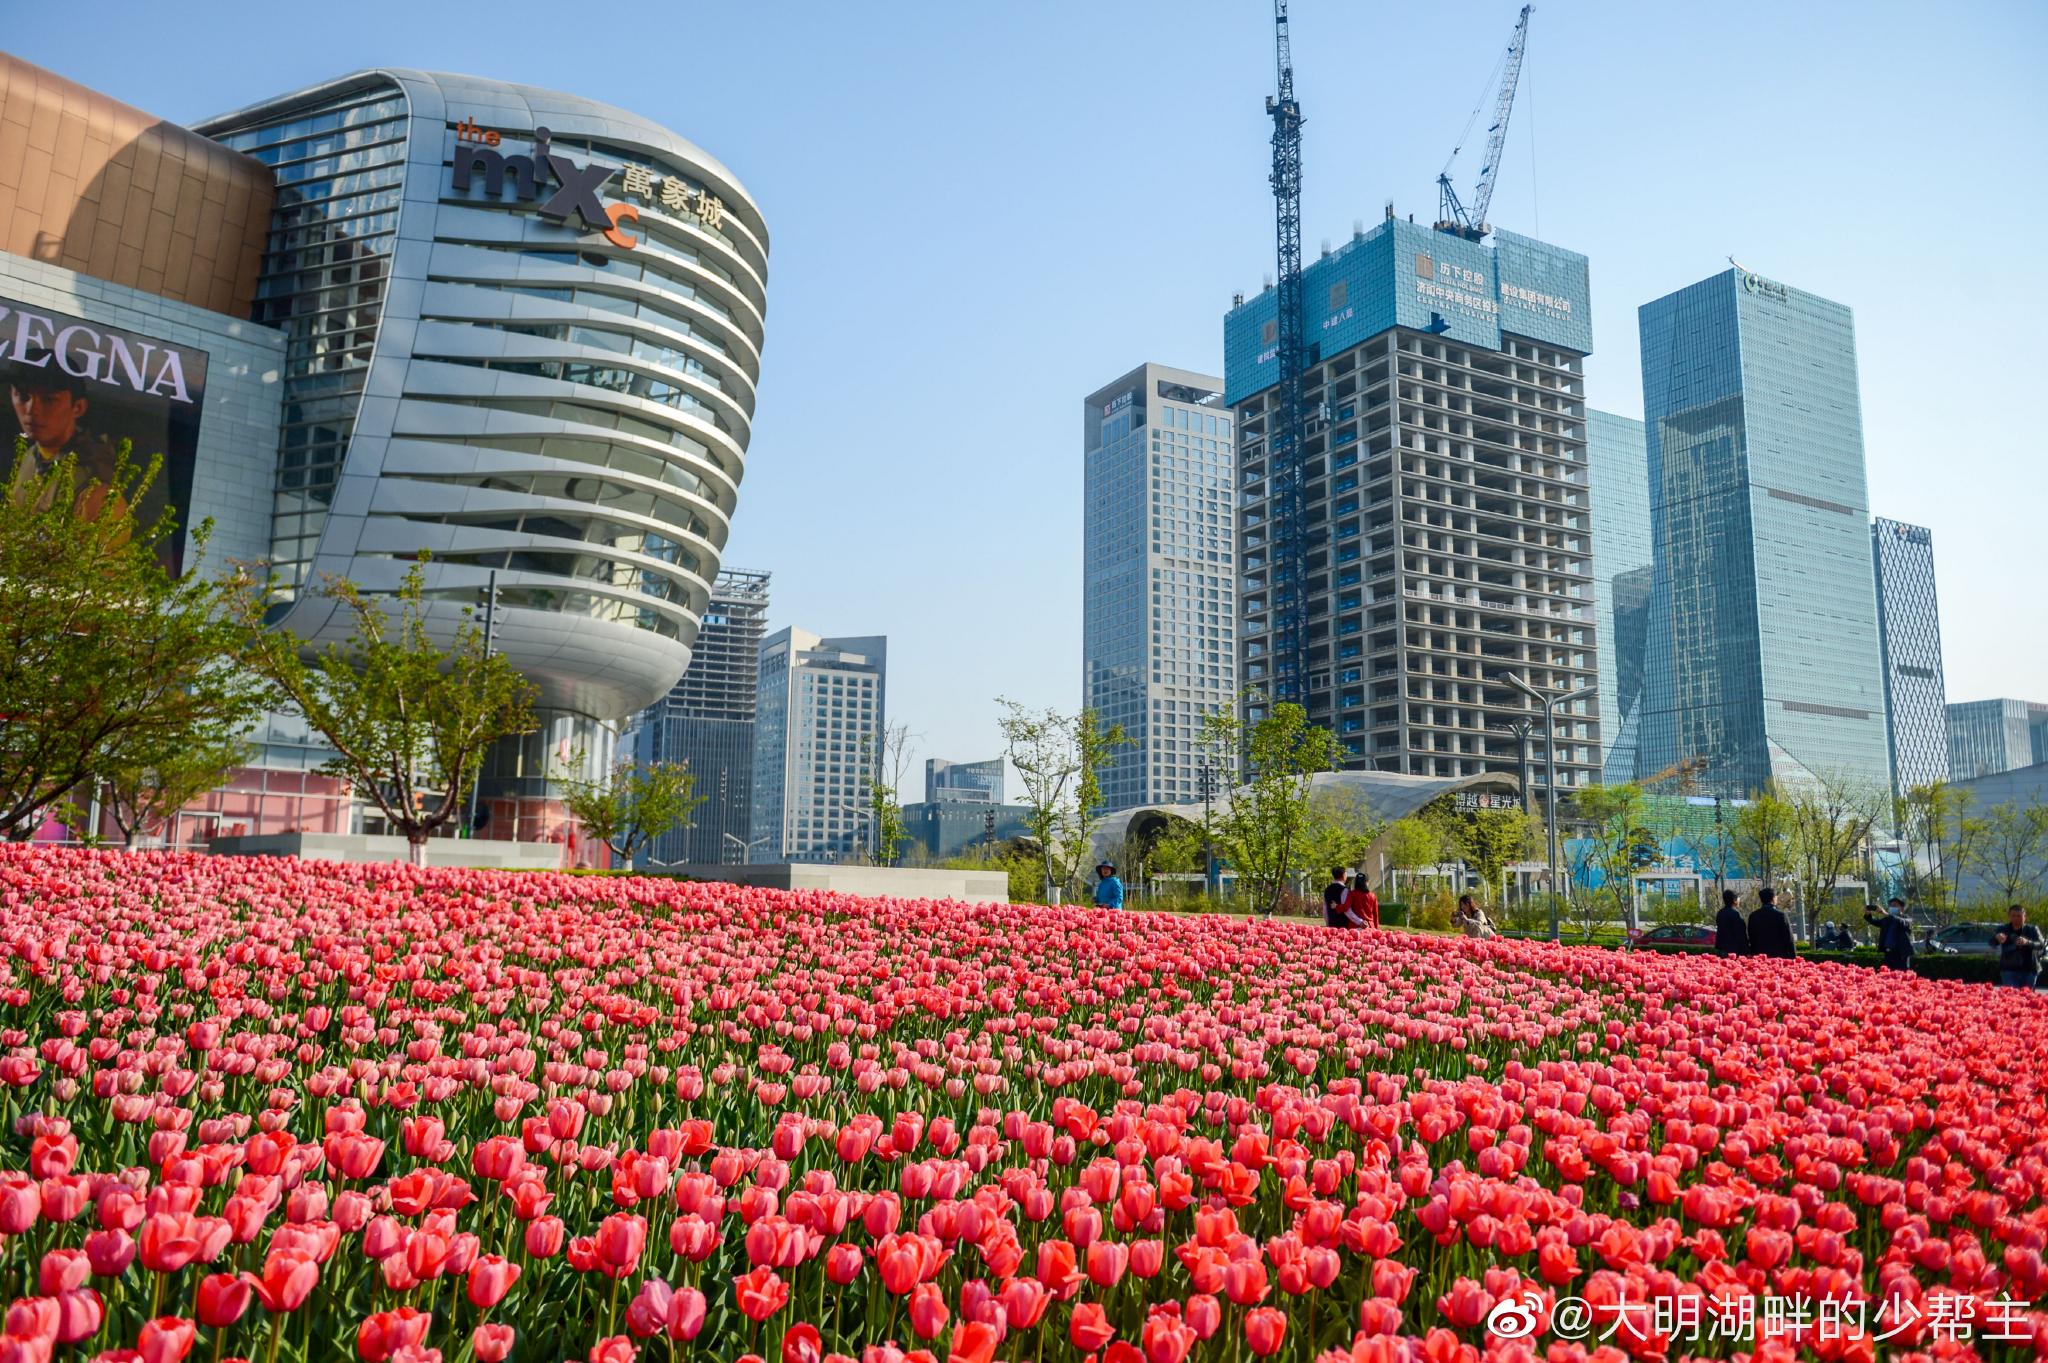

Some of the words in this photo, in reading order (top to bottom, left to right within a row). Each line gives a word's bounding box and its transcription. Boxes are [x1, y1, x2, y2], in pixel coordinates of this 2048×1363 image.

[456, 116, 501, 146] the
[622, 161, 723, 230] 萬象城
[1440, 262, 1484, 285] 历下控股
[0, 306, 194, 404] EGNA
